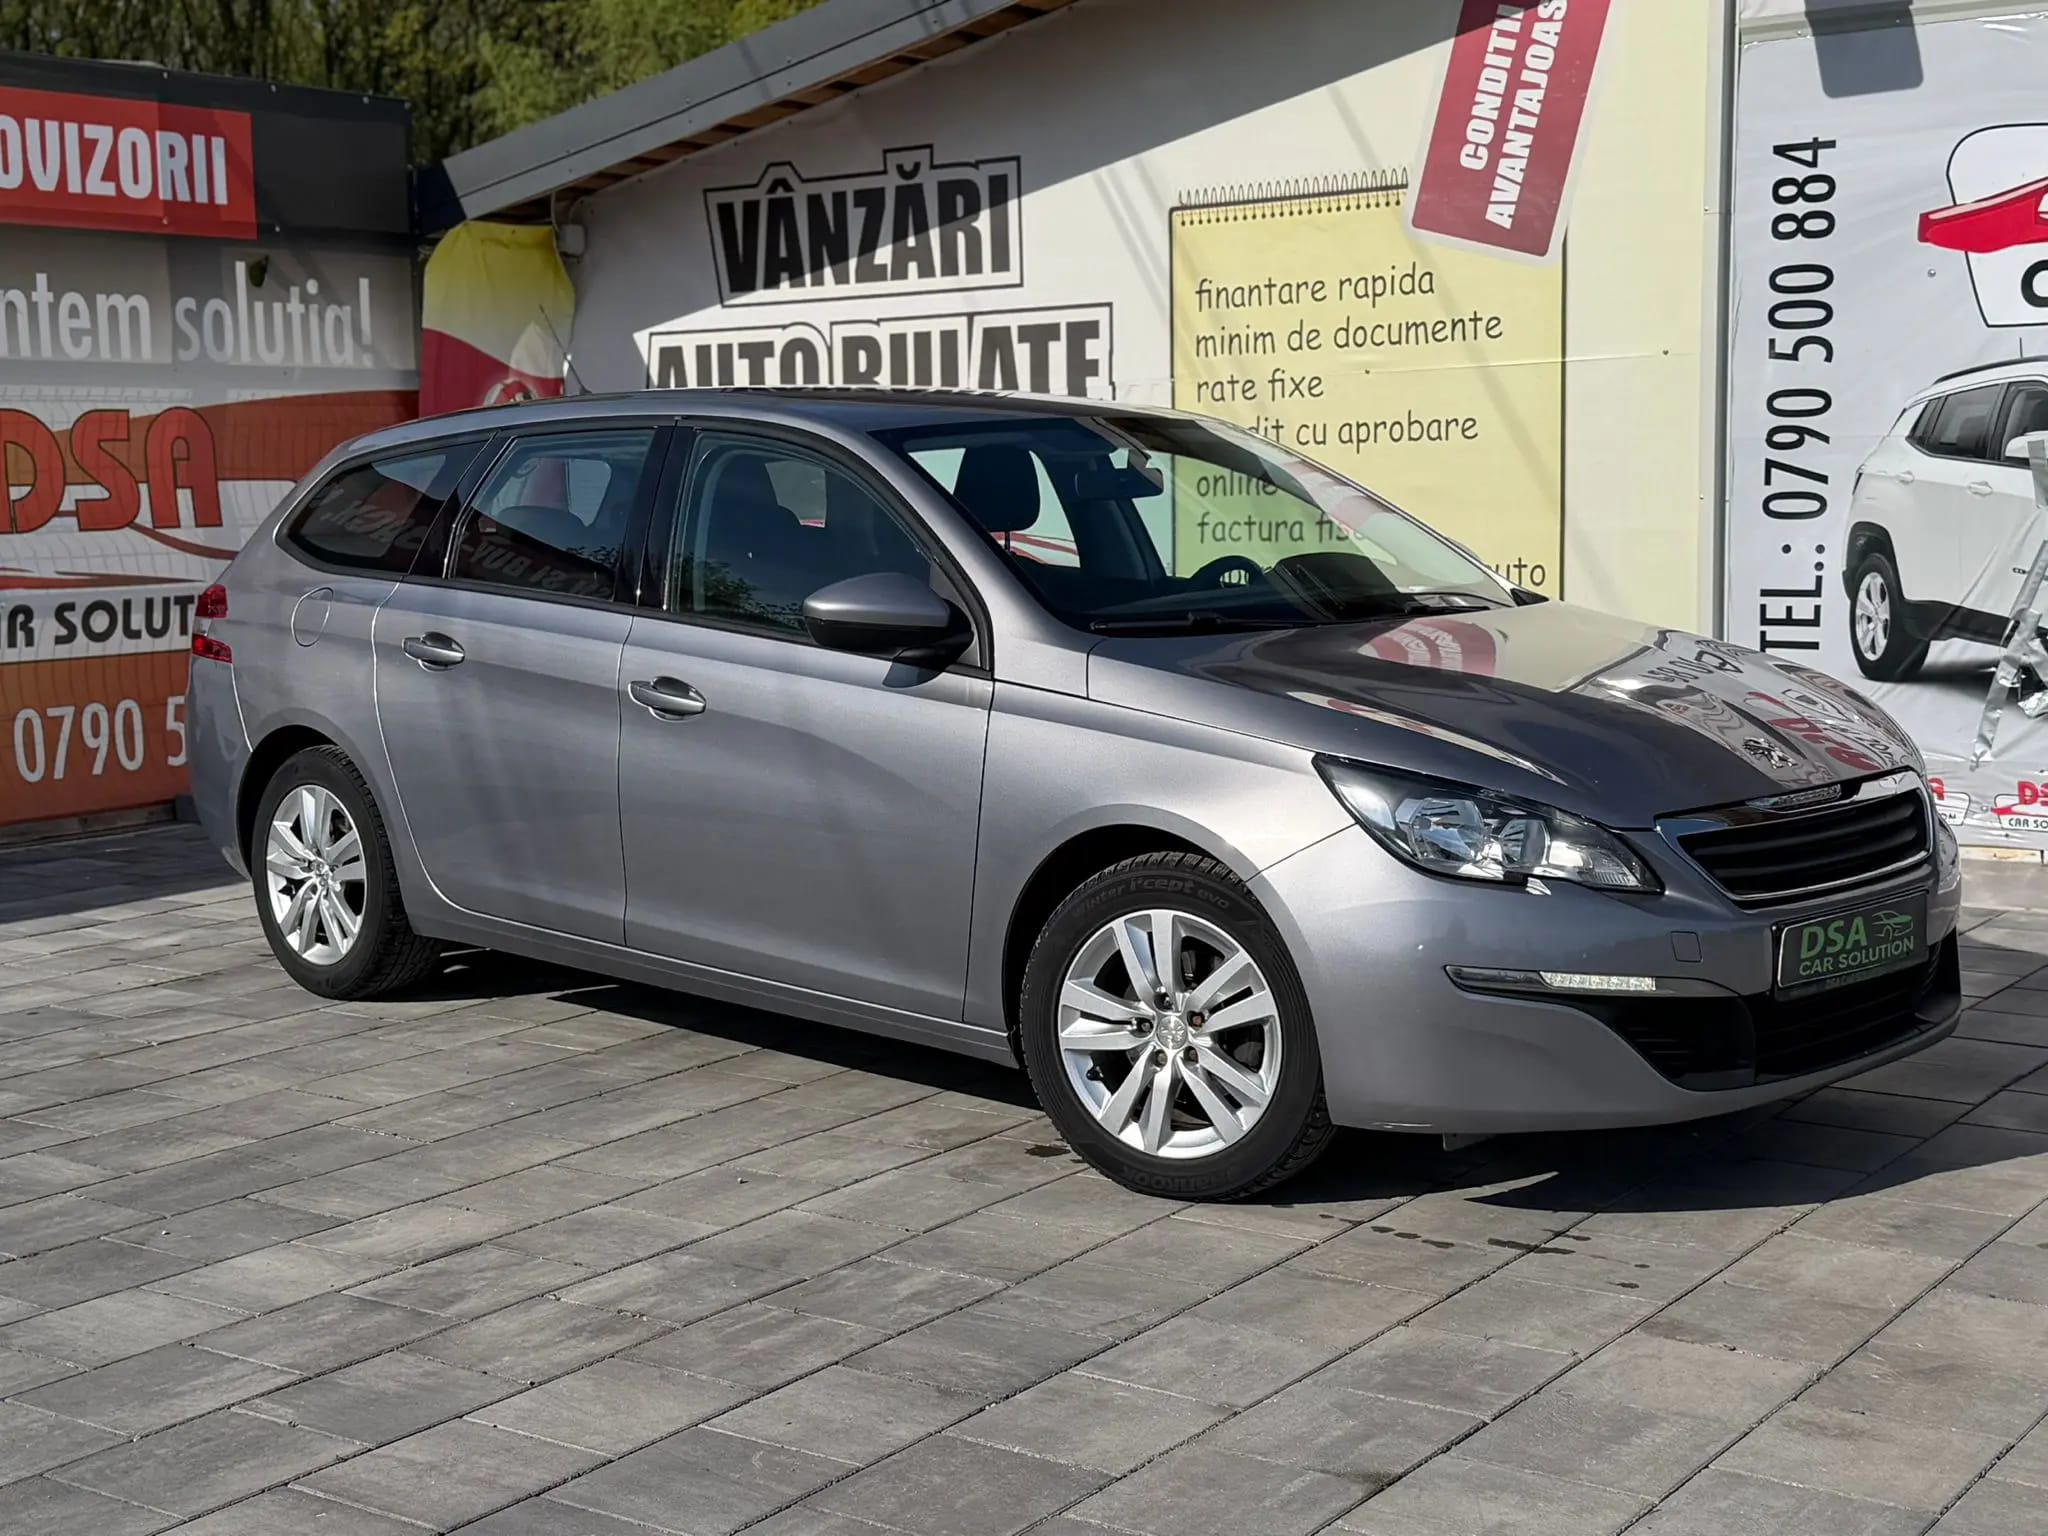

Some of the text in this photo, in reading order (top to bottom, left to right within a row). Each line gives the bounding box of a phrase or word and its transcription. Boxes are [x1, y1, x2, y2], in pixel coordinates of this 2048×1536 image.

[1460, 4, 1524, 170] CONDITII
[1772, 137, 1837, 241] 884
[717, 161, 1011, 293] VÂNZĂRI
[1195, 261, 1435, 312] finantare rapida
[1196, 311, 1504, 358] minim de documente
[1768, 263, 1835, 363] 500
[1197, 368, 1325, 404] rate fixe
[1296, 423, 1327, 446] cu
[1338, 410, 1479, 454] aprobare
[1762, 388, 1832, 520] 0790
[1198, 511, 1304, 544] factura
[1484, 557, 1546, 587] uto
[54, 595, 201, 646] SOLUT
[14, 698, 144, 783] 0790
[1800, 957, 1833, 976] CAR
[1838, 936, 1915, 968] SOLUTION
[1801, 916, 1868, 959] DSA
